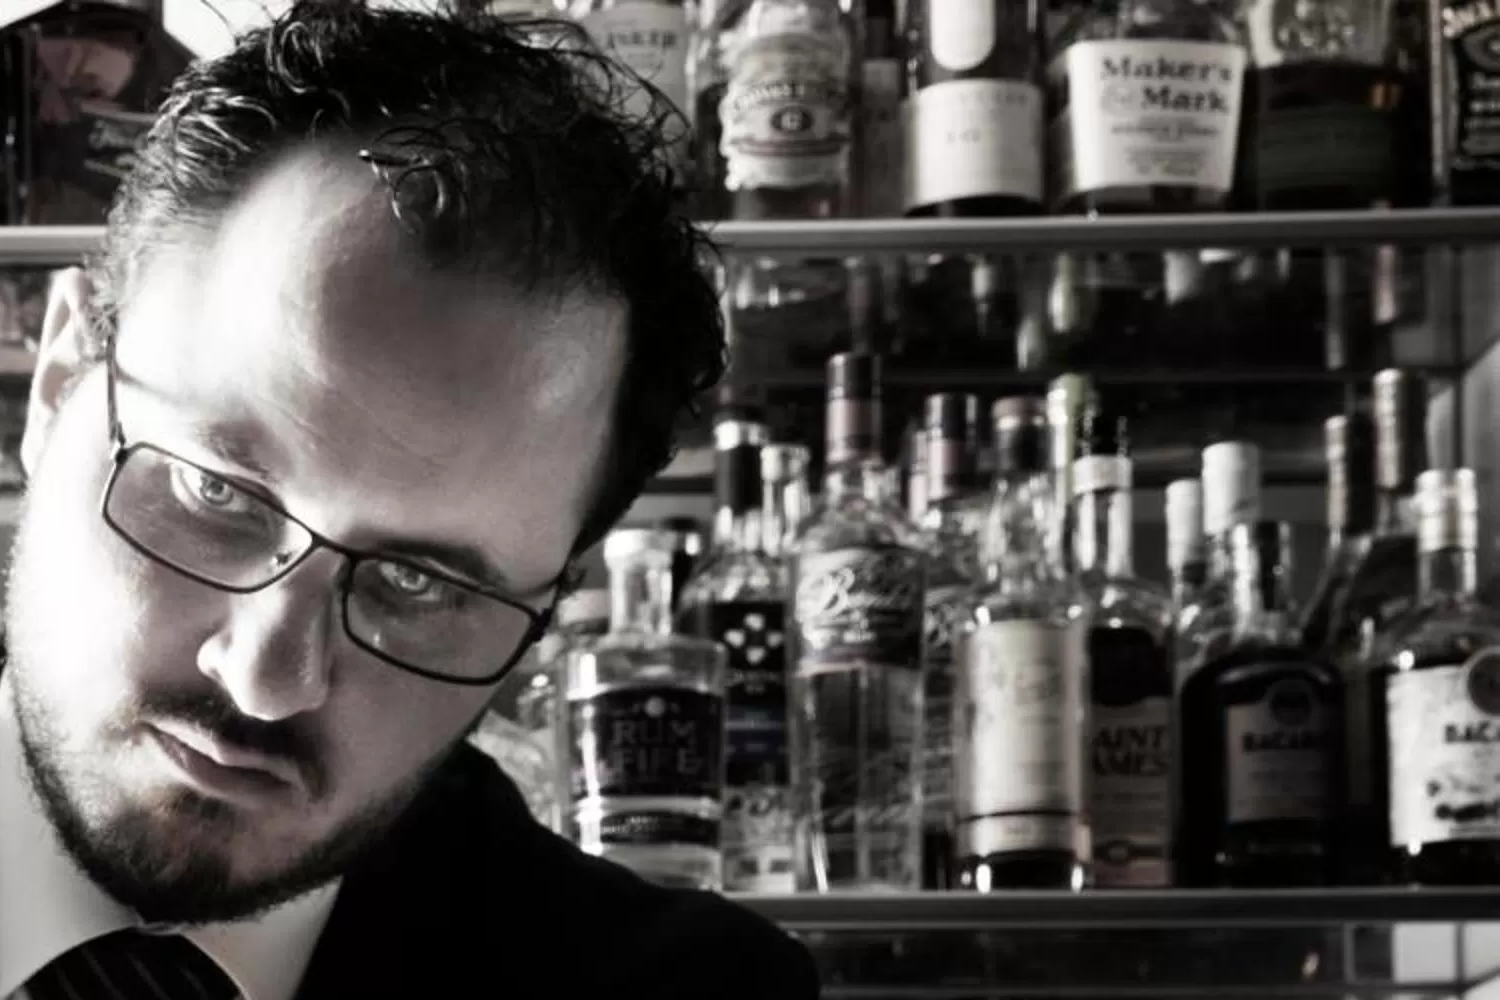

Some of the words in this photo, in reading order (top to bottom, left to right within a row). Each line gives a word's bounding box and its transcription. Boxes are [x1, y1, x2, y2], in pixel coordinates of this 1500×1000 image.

[1101, 55, 1232, 84] Maker's
[1140, 84, 1229, 114] Mark
[612, 719, 696, 746] RUM
